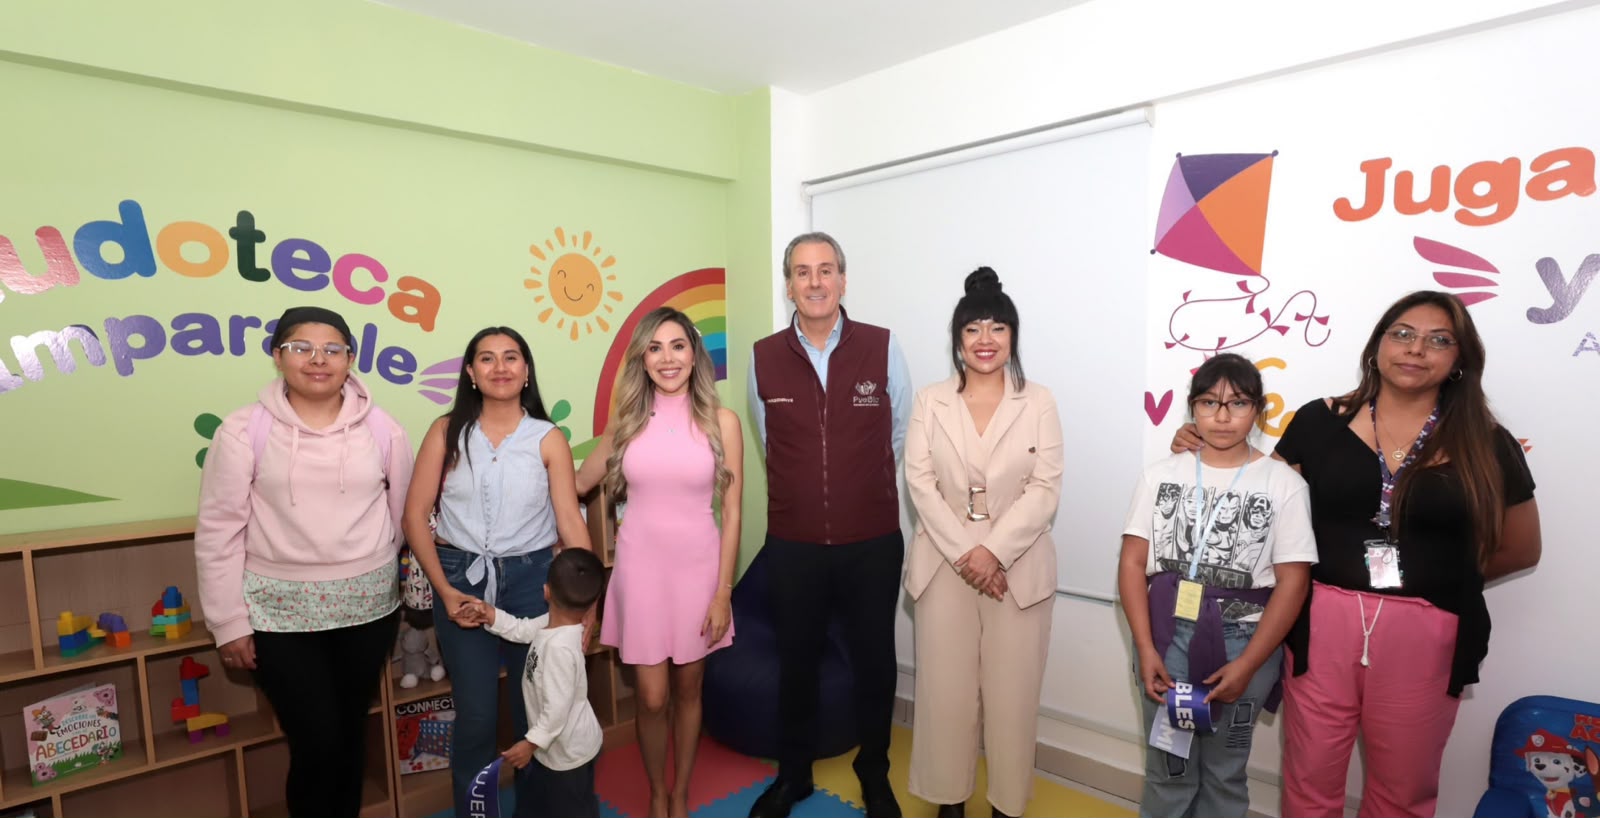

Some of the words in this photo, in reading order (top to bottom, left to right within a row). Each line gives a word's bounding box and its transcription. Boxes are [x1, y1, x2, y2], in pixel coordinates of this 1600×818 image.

[0, 199, 441, 332] udoteca
[1175, 681, 1196, 730] BLES
[36, 725, 117, 761] ABECEDARIO
[56, 719, 101, 738] EMOCIONES
